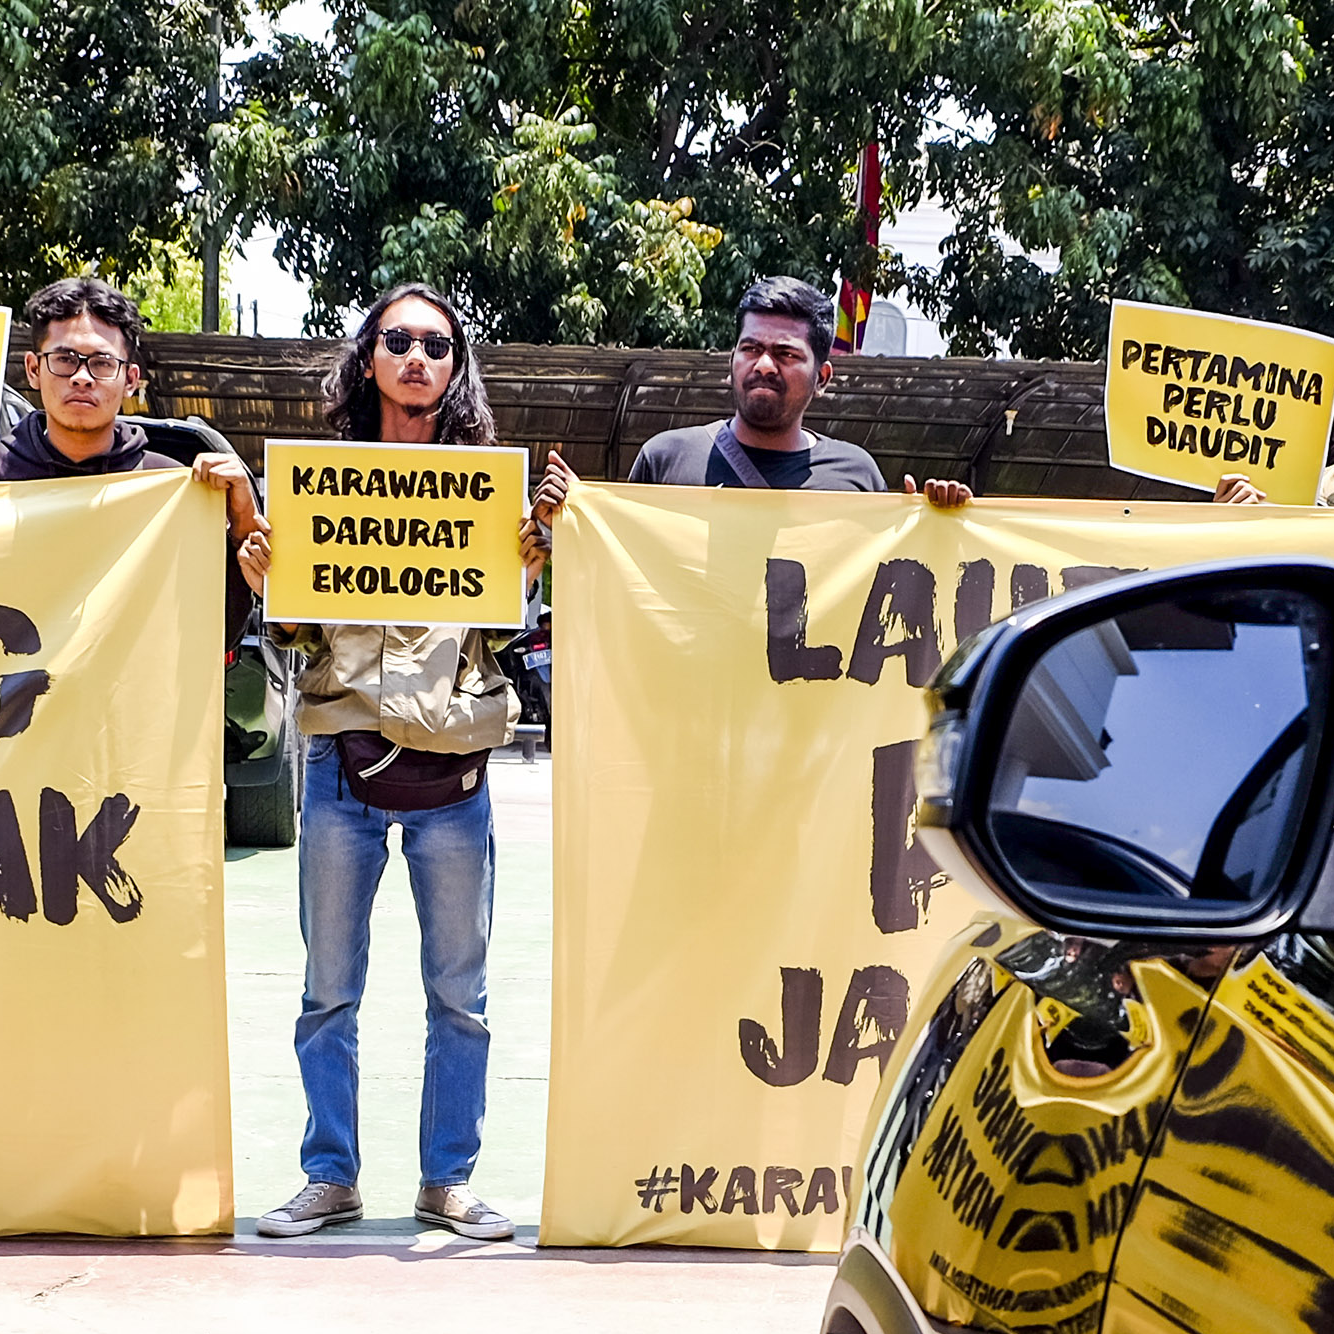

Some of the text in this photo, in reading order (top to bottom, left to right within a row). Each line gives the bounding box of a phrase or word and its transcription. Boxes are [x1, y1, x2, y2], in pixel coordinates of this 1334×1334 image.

[1121, 339, 1323, 406] PERTAMINA
[1163, 382, 1277, 432] PERLU
[1145, 413, 1286, 470] DIAUDIT
[292, 465, 495, 502] KARAWANG
[312, 515, 475, 550] DARURAT
[312, 563, 485, 598] EKOLOGIS
[634, 1163, 854, 1218] #KARA
